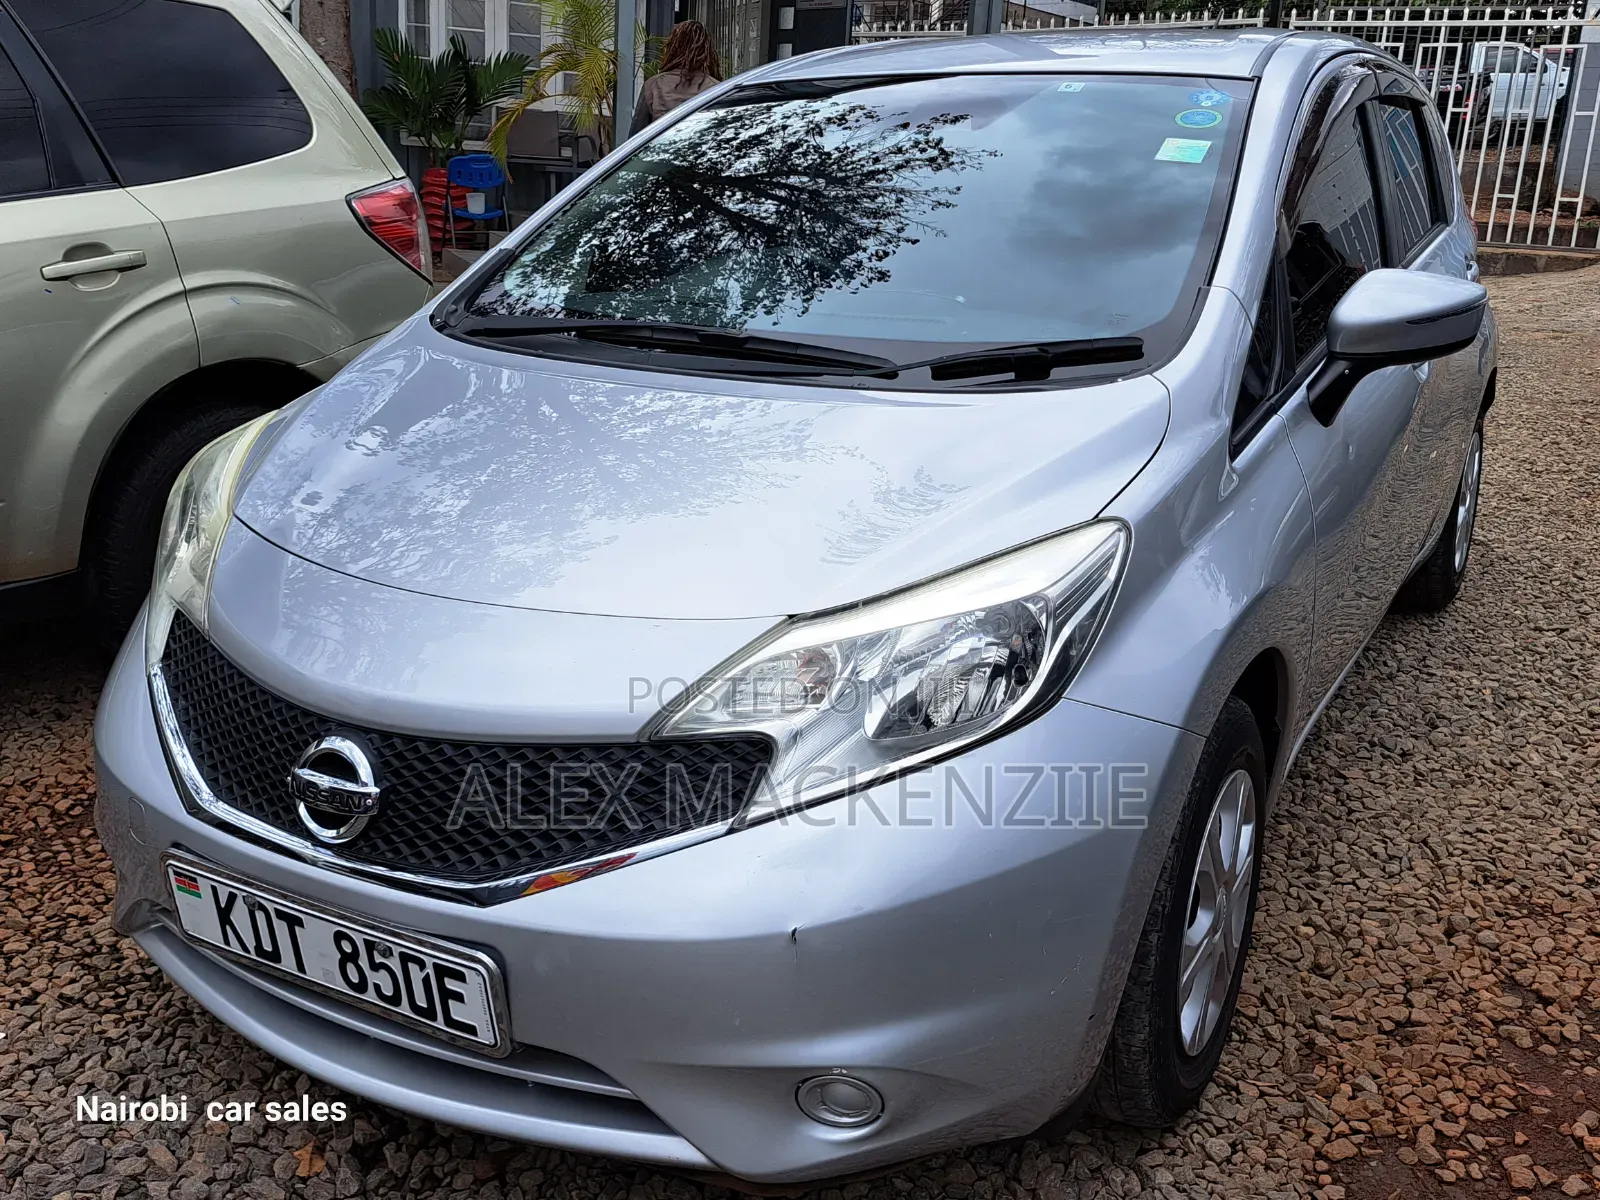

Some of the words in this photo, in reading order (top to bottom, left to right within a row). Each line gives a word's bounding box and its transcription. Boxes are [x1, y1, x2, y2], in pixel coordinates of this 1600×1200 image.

[289, 776, 364, 812] NISSAN
[210, 883, 308, 975] KDT
[332, 929, 479, 1037] 850E
